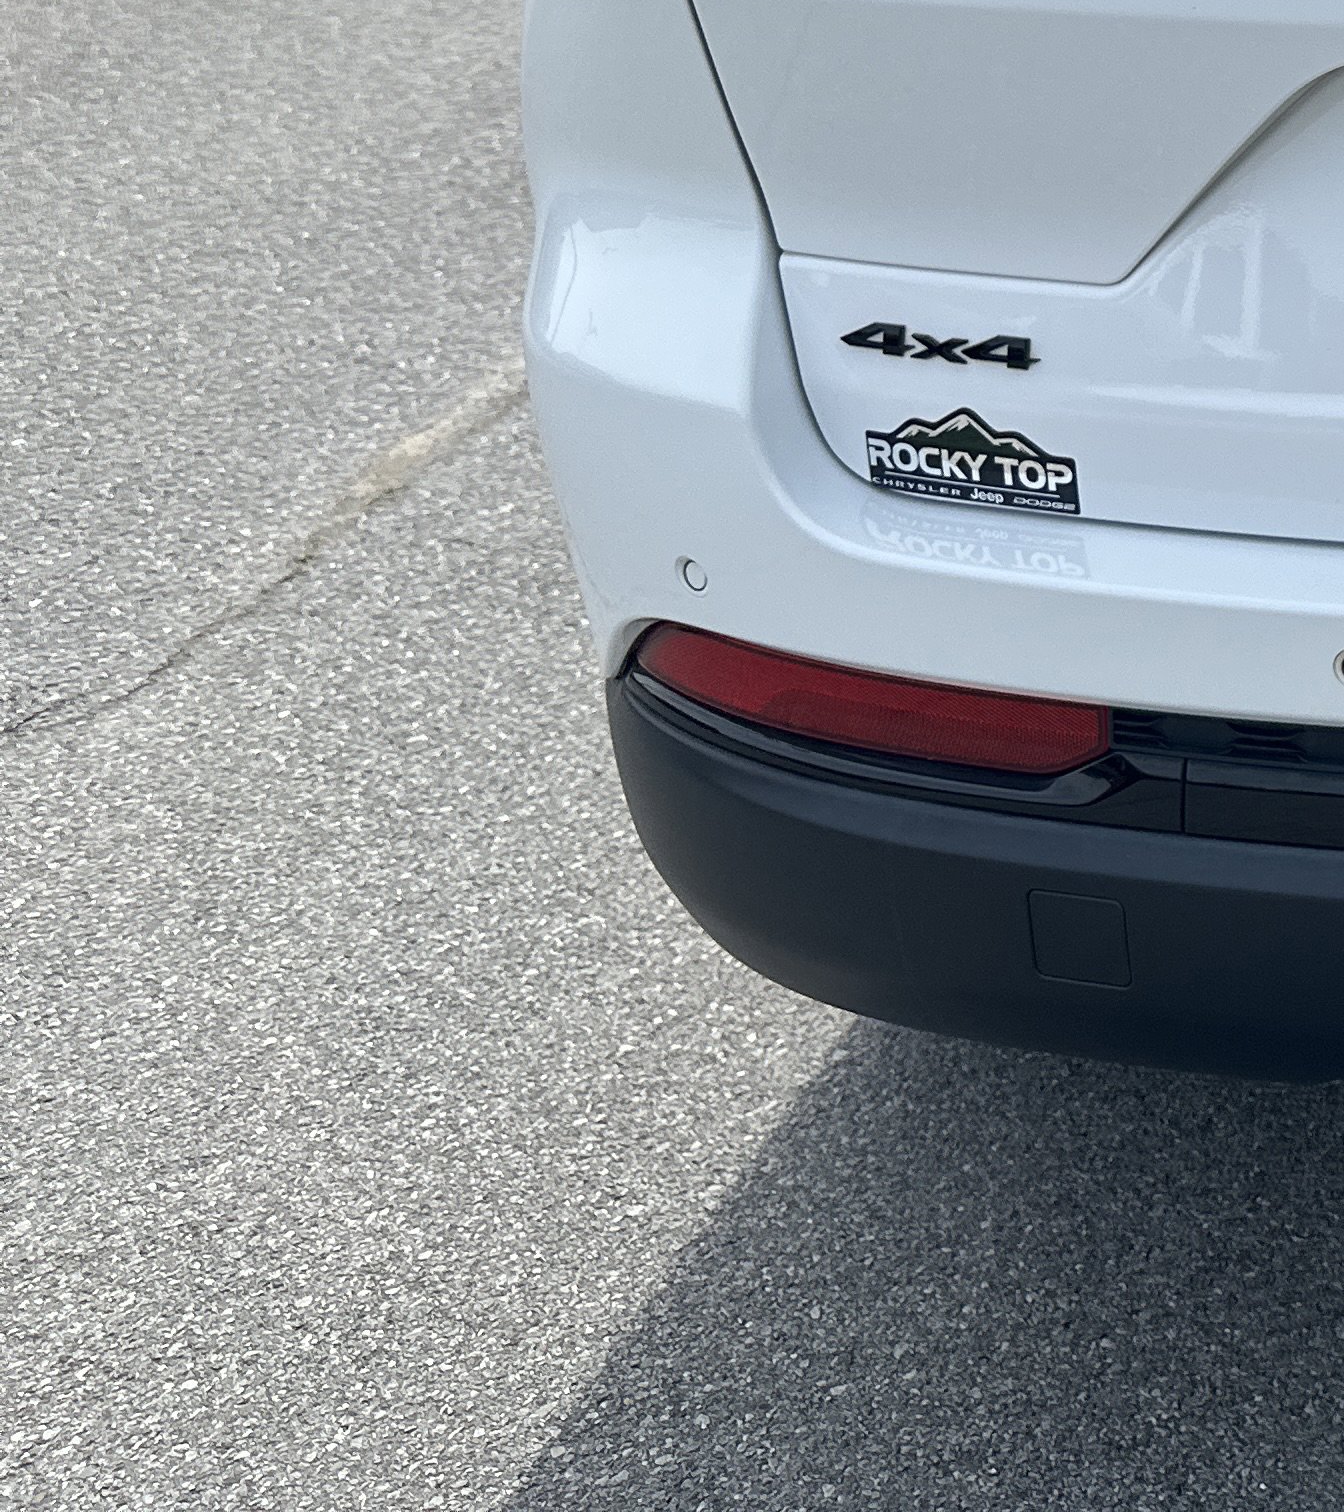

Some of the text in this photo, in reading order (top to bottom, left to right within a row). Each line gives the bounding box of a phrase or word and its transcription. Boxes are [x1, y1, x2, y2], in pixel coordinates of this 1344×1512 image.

[840, 322, 1041, 370] 4x4
[868, 438, 1074, 492] ROCKY TOP
[872, 477, 1077, 511] CHRYSLER Jeep DODGE
